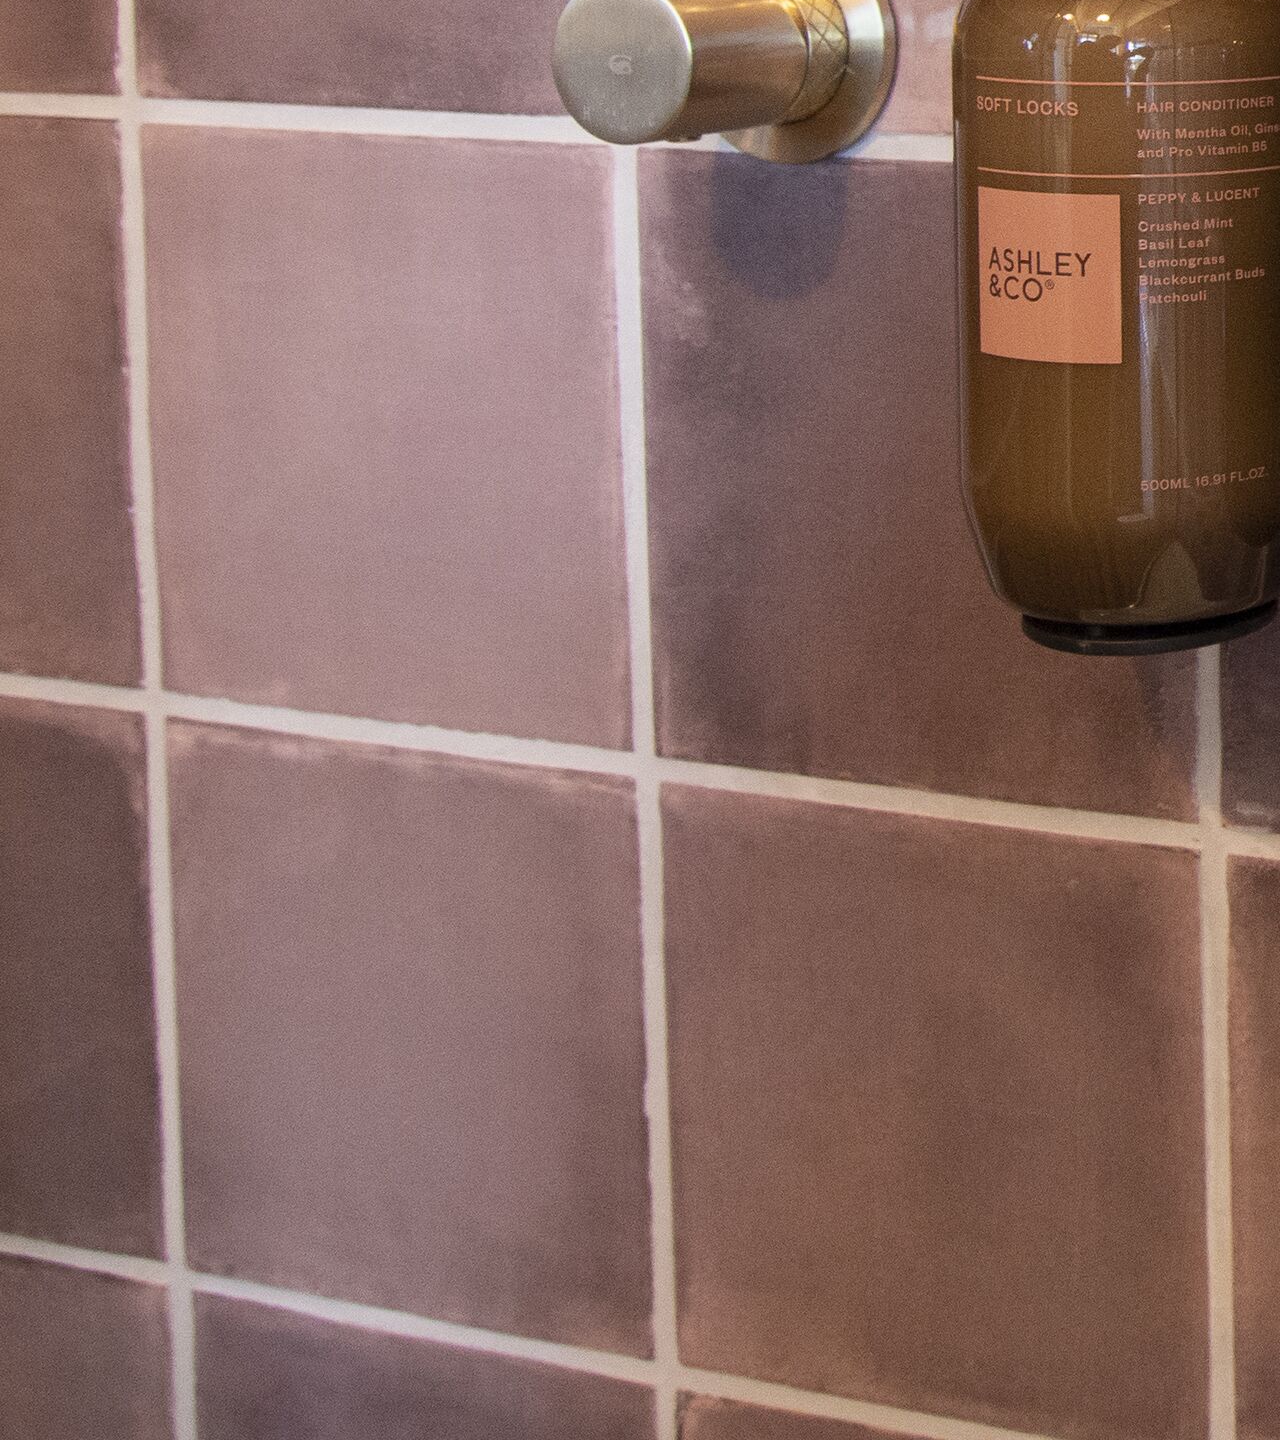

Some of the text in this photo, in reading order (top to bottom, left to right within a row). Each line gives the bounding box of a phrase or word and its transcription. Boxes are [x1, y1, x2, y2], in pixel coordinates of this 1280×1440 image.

[976, 96, 1079, 116] SOFT LOCKS
[1137, 96, 1275, 113] HAIR CONDITIONER
[1137, 128, 1170, 140] With
[1175, 127, 1226, 139] Mentha
[1137, 141, 1268, 158] and Pro Vitamin B5
[1138, 187, 1260, 205] PEPPY & LUCENT
[1138, 218, 1233, 232] Crushed Mint
[1138, 236, 1211, 250] Basil Leaf
[988, 246, 1092, 277] ASHLEY
[1138, 255, 1225, 269] Lemongrass
[1138, 267, 1265, 286] Blackcurrant Buds
[1139, 290, 1207, 304] Patchouli
[1140, 478, 1191, 491] 500ML
[1196, 474, 1226, 486] 16.91
